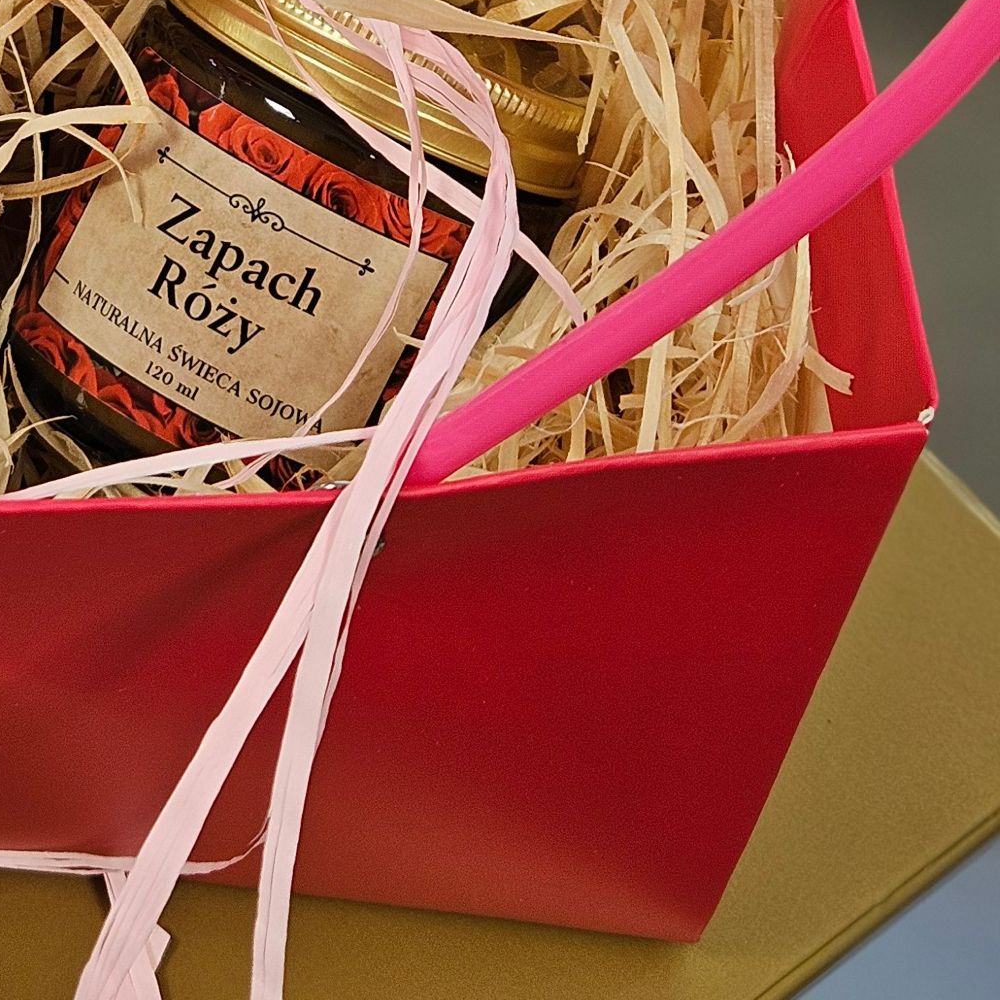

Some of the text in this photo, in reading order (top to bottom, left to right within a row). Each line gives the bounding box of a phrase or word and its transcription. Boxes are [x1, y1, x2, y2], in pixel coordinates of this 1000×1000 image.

[157, 193, 323, 317] Zapach
[73, 280, 164, 354] NATURALNA
[147, 255, 266, 355] Róży
[145, 361, 200, 402] 120 ml
